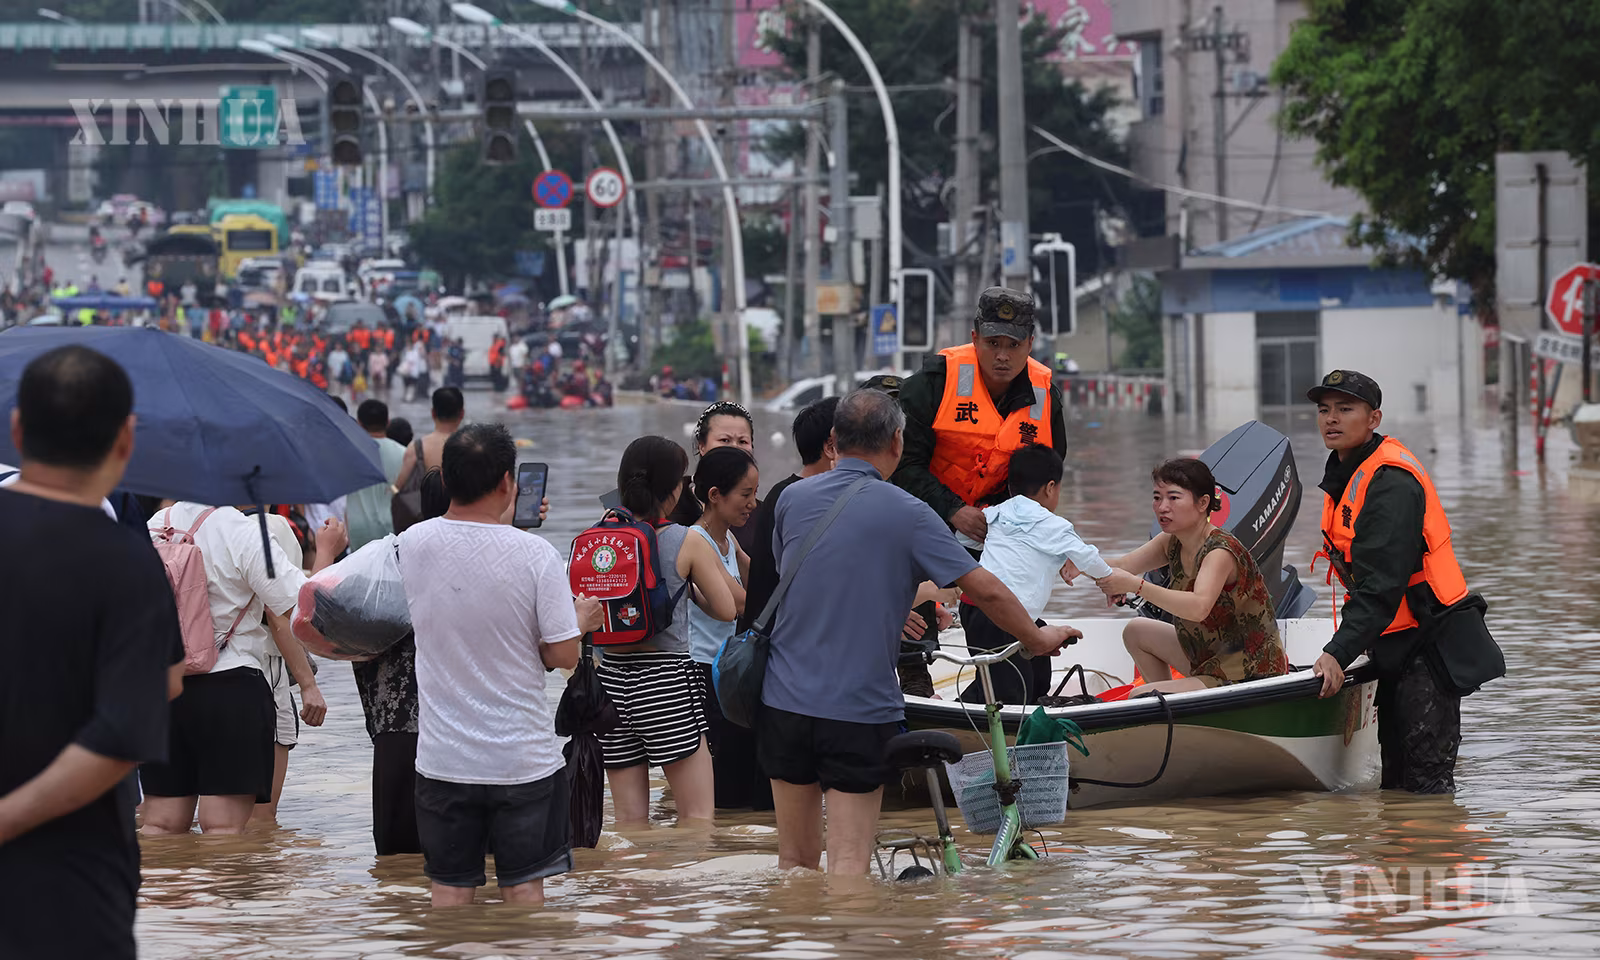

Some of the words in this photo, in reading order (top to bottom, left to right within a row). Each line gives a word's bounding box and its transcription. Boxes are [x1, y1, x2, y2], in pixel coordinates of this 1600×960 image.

[595, 178, 617, 197] 60
[954, 402, 979, 424] 武
[1018, 421, 1038, 446] 警
[1252, 481, 1286, 532] YAMAHA
